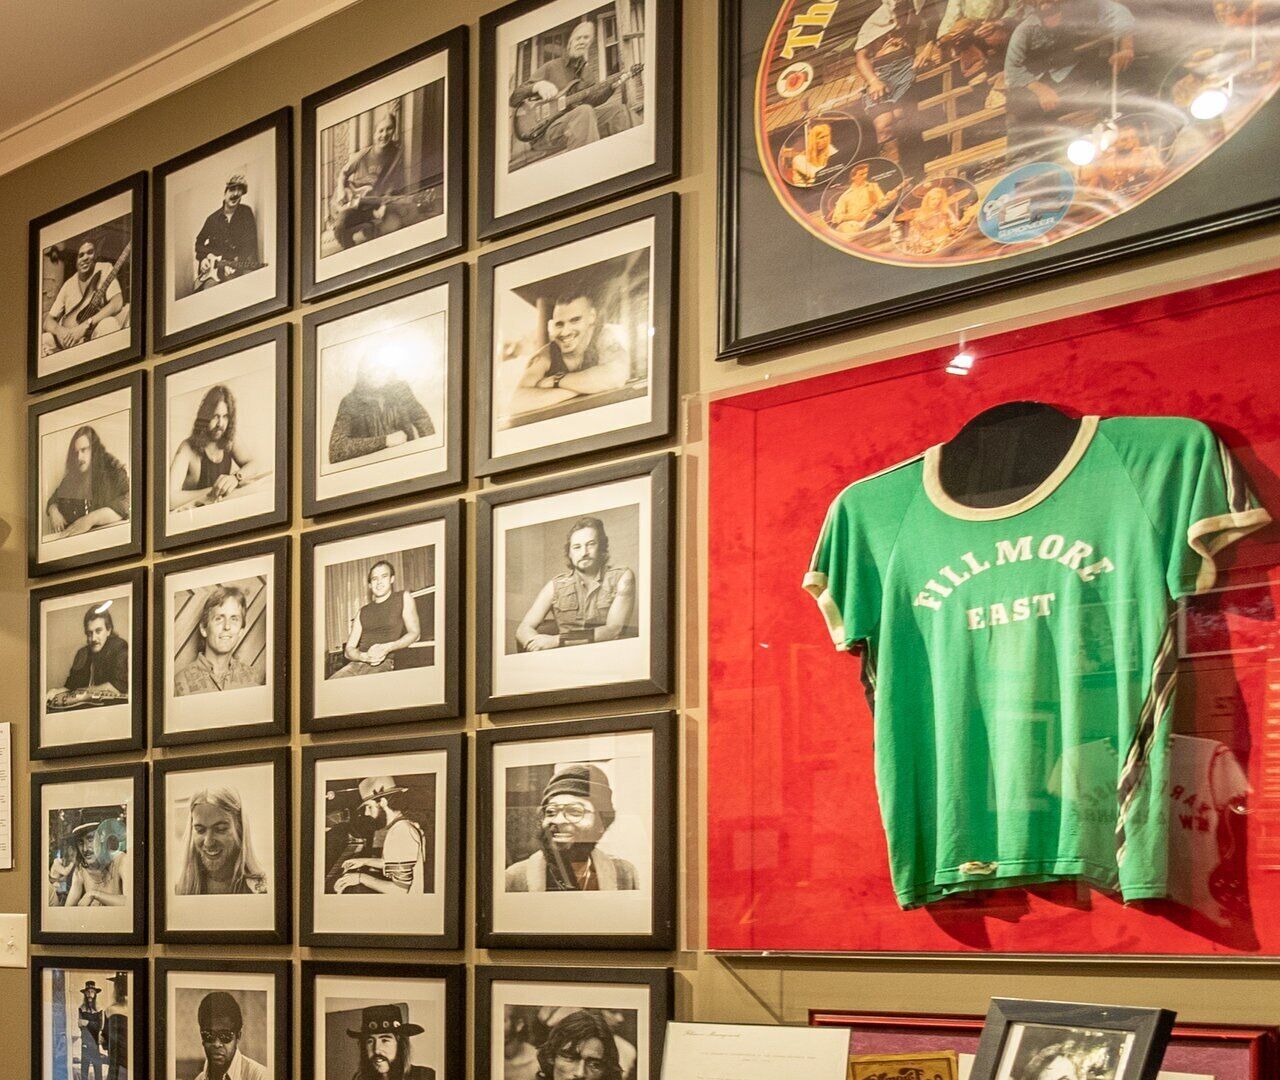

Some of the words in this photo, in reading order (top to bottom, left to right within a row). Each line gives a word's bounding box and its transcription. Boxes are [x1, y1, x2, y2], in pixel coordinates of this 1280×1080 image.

[780, 0, 839, 60] Th
[913, 534, 1115, 612] FILLMORE
[966, 592, 1056, 631] EAST
